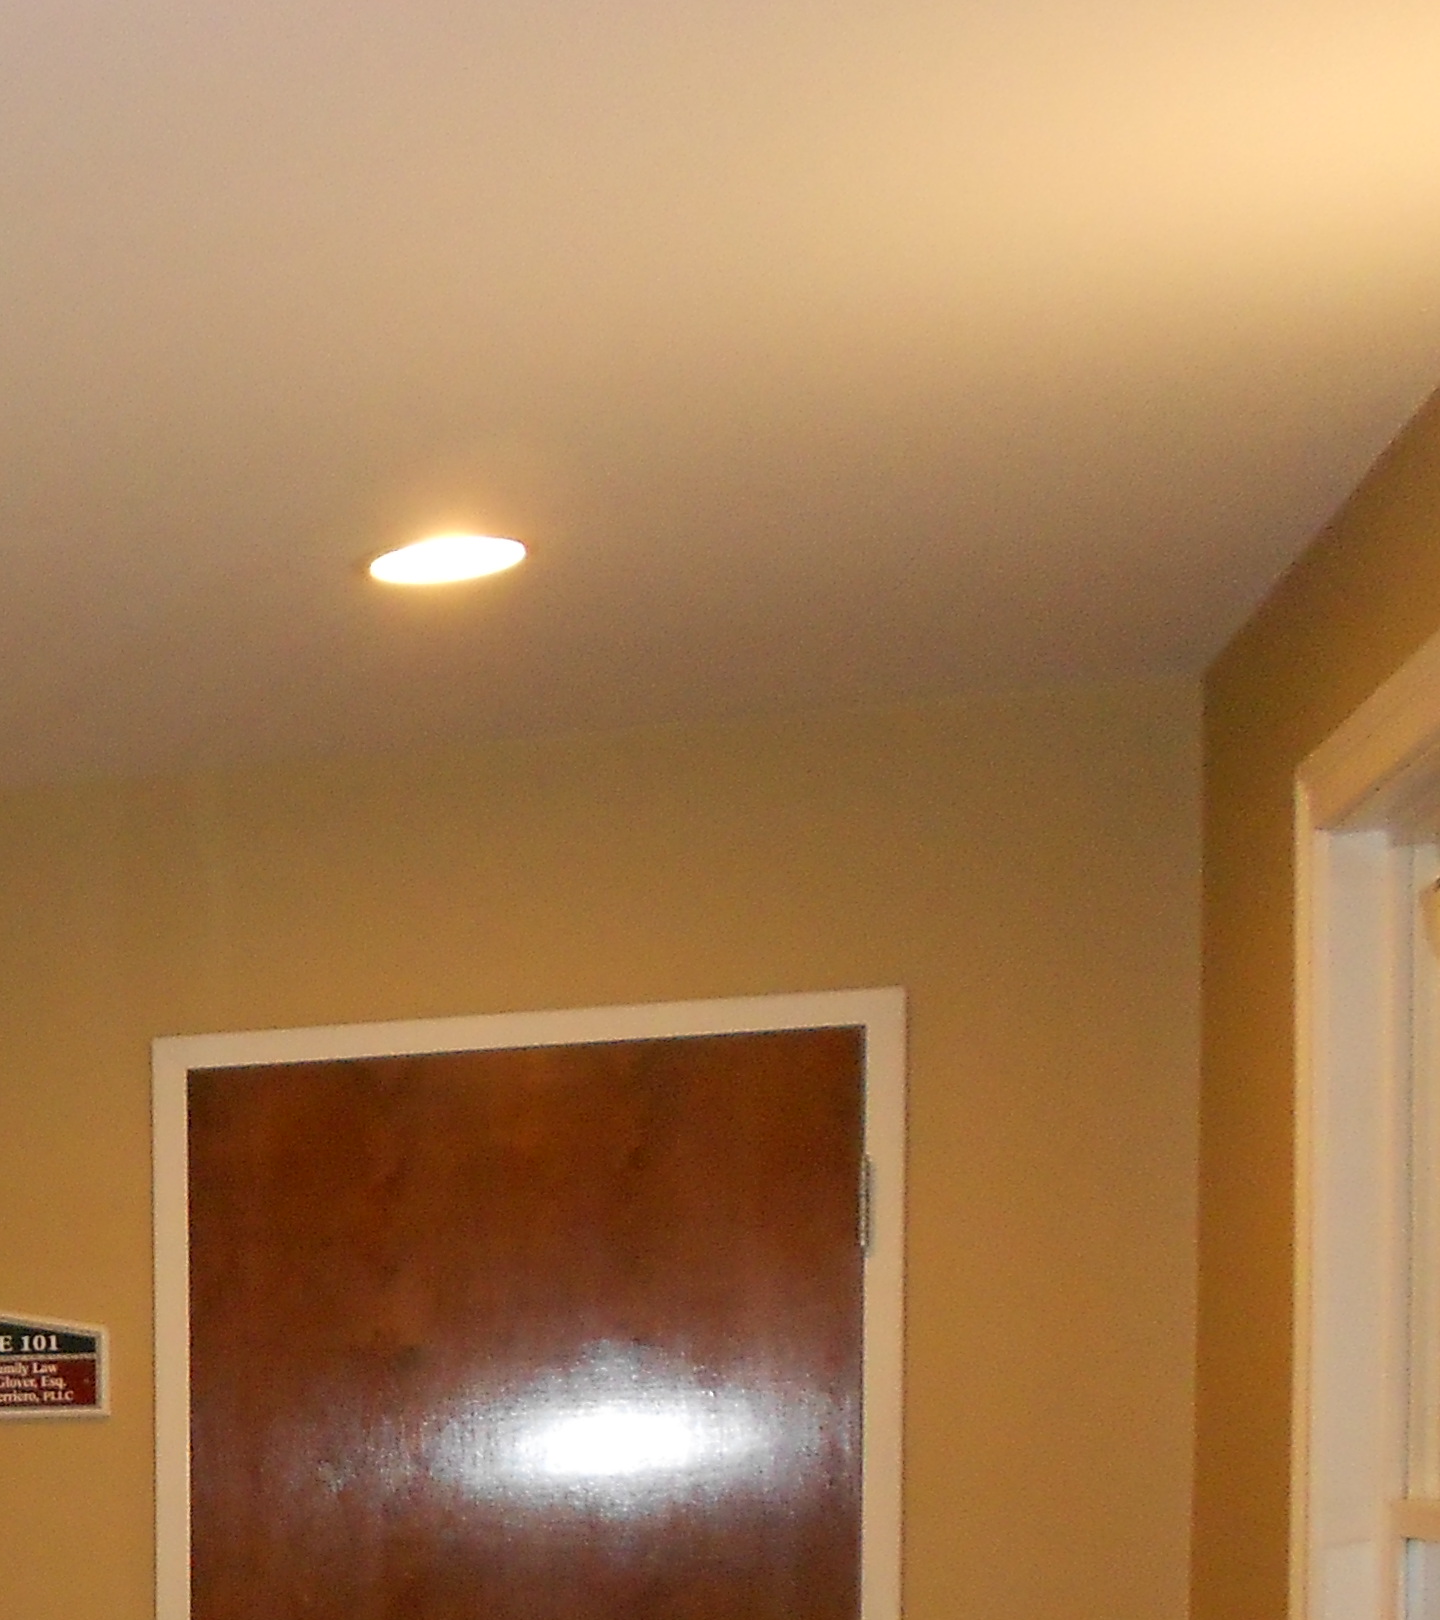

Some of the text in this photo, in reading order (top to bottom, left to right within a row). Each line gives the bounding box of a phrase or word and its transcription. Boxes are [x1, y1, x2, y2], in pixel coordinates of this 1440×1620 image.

[21, 1334, 60, 1351] 101
[33, 1362, 57, 1374] Law
[41, 1375, 67, 1388] Esq.
[43, 1391, 74, 1401] PLLC
